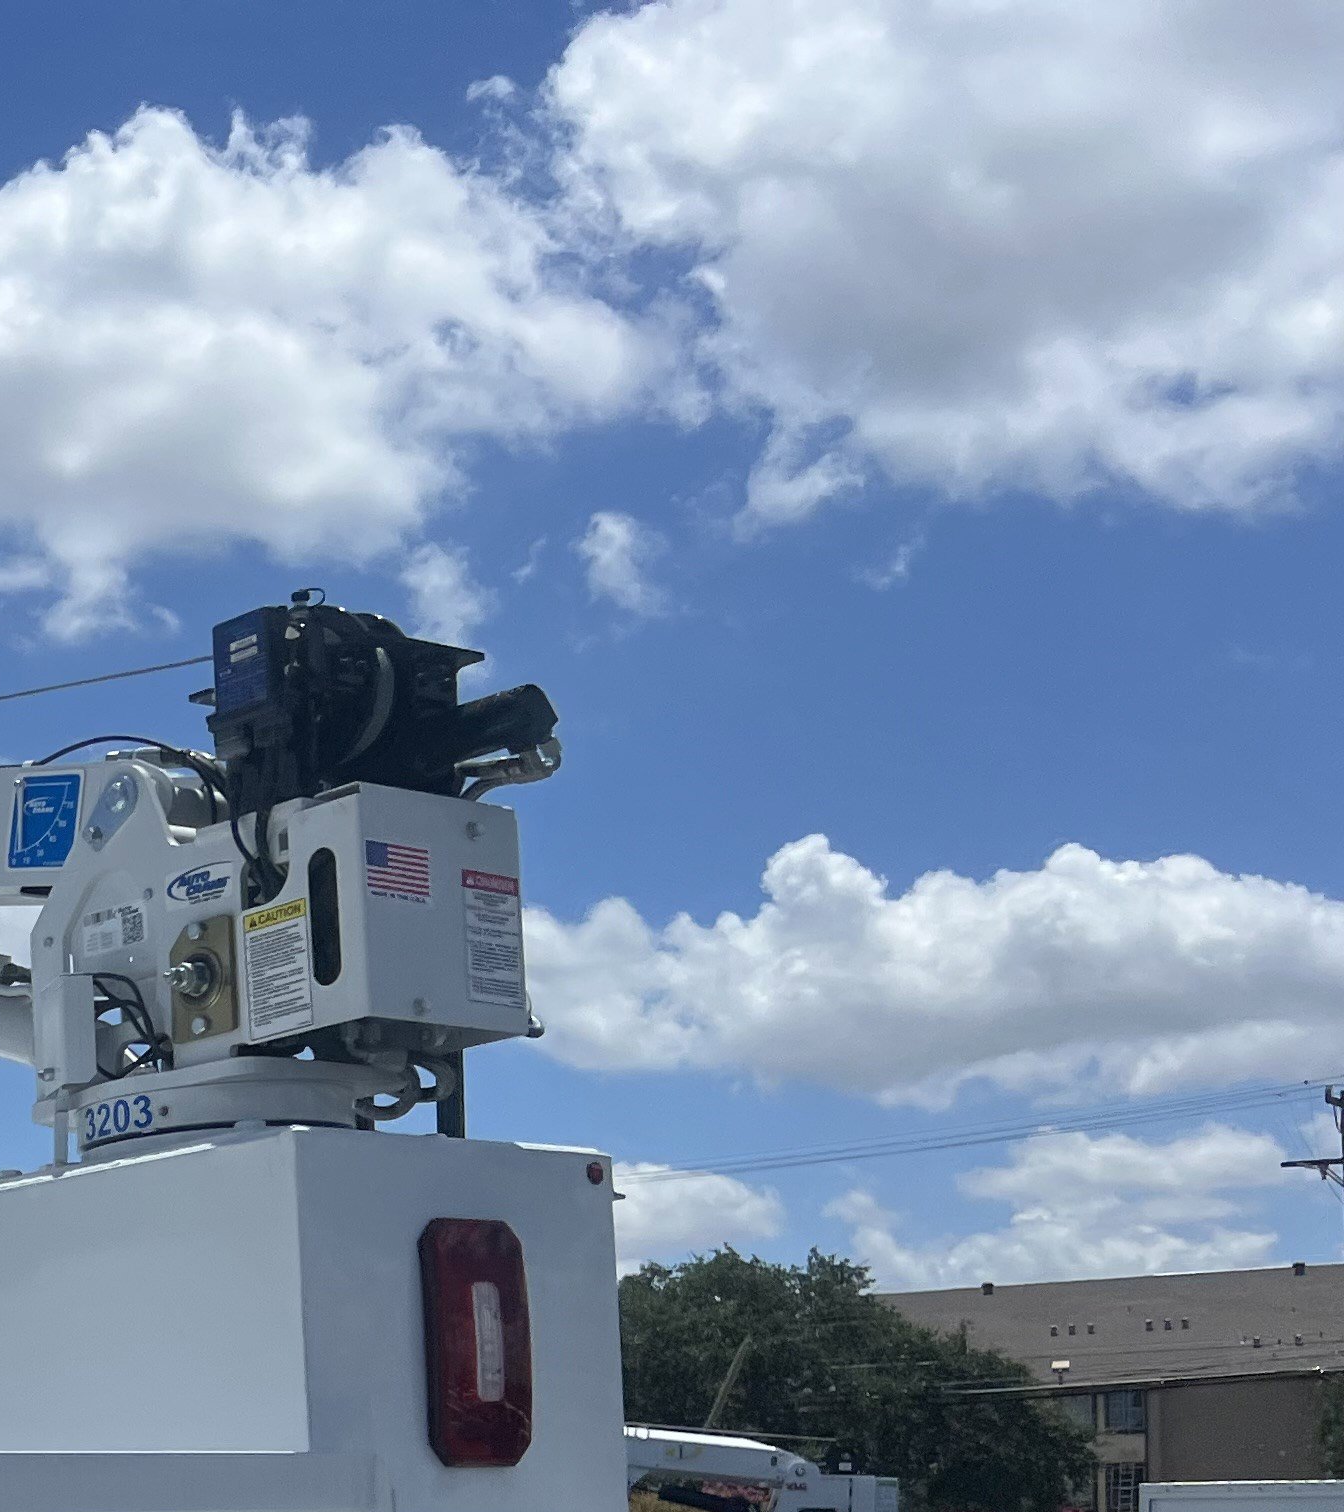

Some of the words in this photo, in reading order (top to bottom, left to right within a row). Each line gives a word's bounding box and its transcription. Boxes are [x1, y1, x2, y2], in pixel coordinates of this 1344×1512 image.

[177, 870, 210, 889] AUTO
[258, 903, 301, 924] CAUTION
[85, 1095, 153, 1140] 3203
